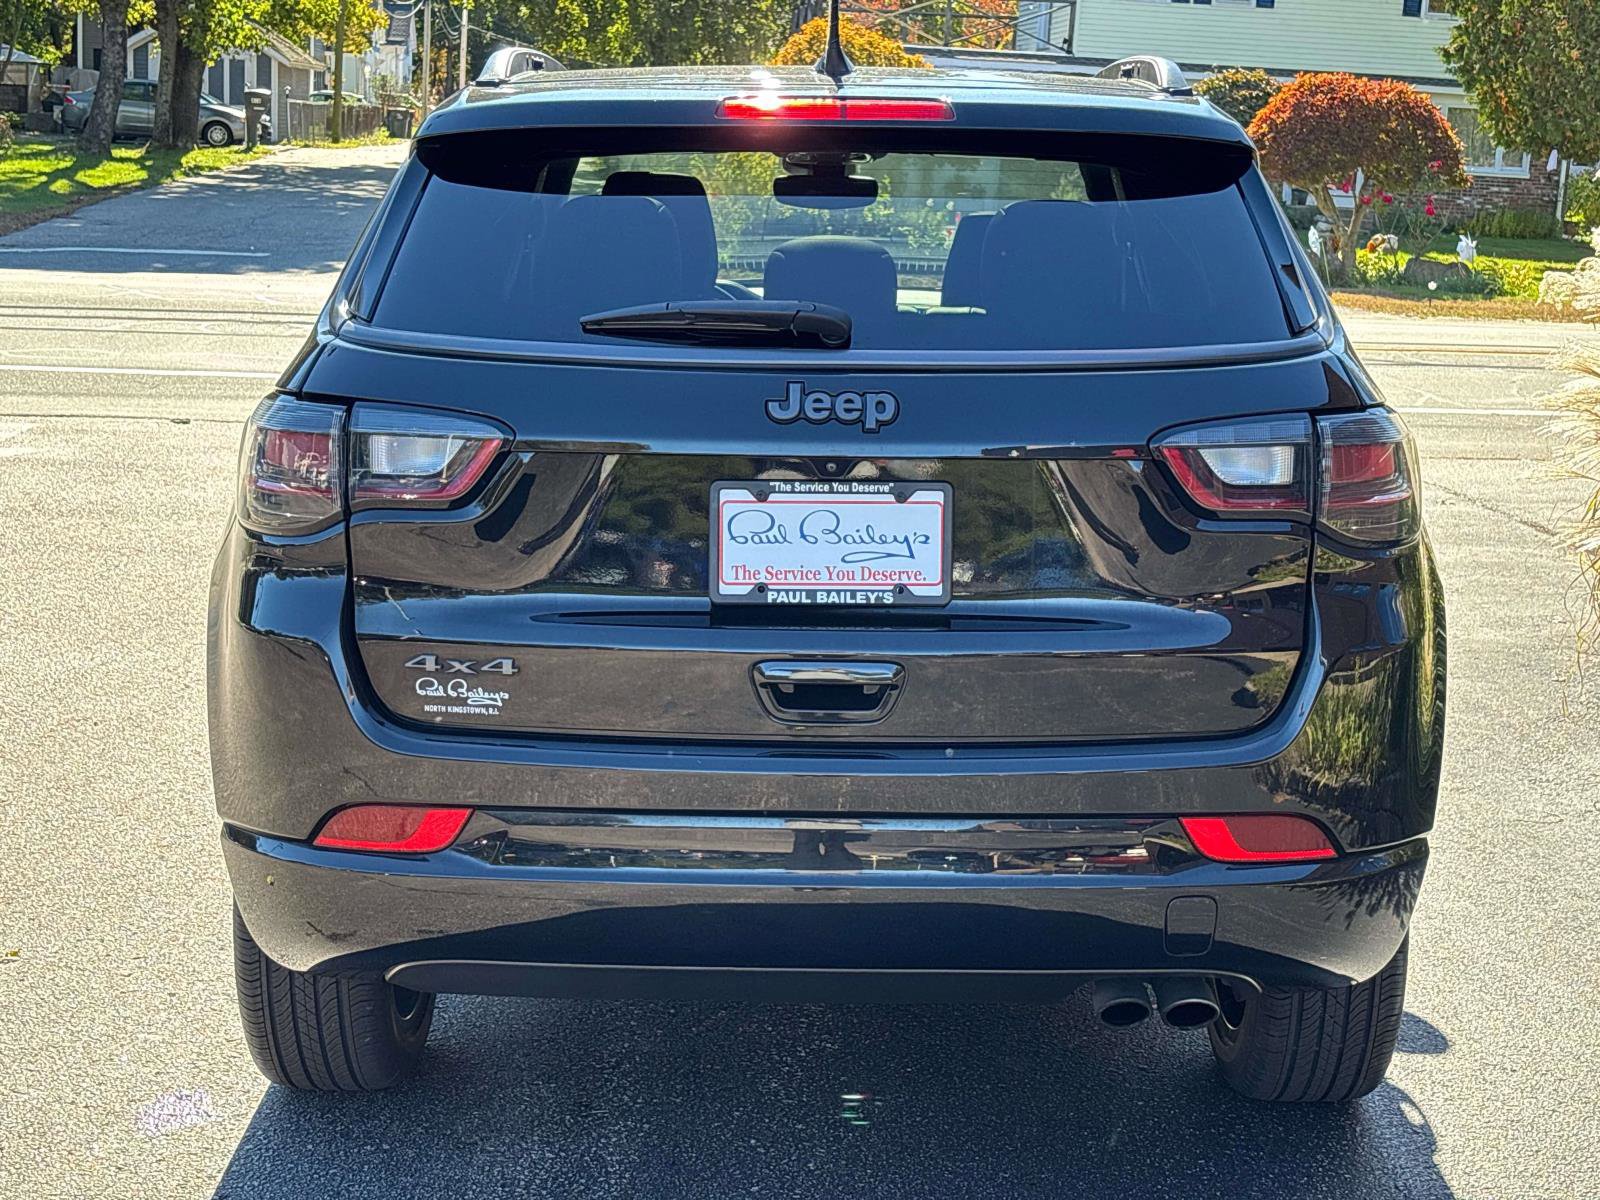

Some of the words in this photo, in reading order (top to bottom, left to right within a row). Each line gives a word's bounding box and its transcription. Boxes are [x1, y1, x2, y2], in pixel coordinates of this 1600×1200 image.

[766, 382, 898, 431] Jeep
[794, 481, 829, 493] Service
[832, 482, 849, 493] You
[727, 509, 793, 545] Paul
[799, 509, 931, 564] Bailey's
[731, 565, 761, 582] The
[764, 565, 821, 582] Service
[825, 565, 857, 582] You
[860, 565, 927, 582] Deserve.
[767, 591, 812, 604] PAUL
[816, 591, 894, 604] BAILEY'S
[404, 654, 519, 675] 4x4
[415, 677, 447, 696] Paul
[424, 704, 446, 713] NORTH
[447, 705, 488, 716] KINGSTOWN,
